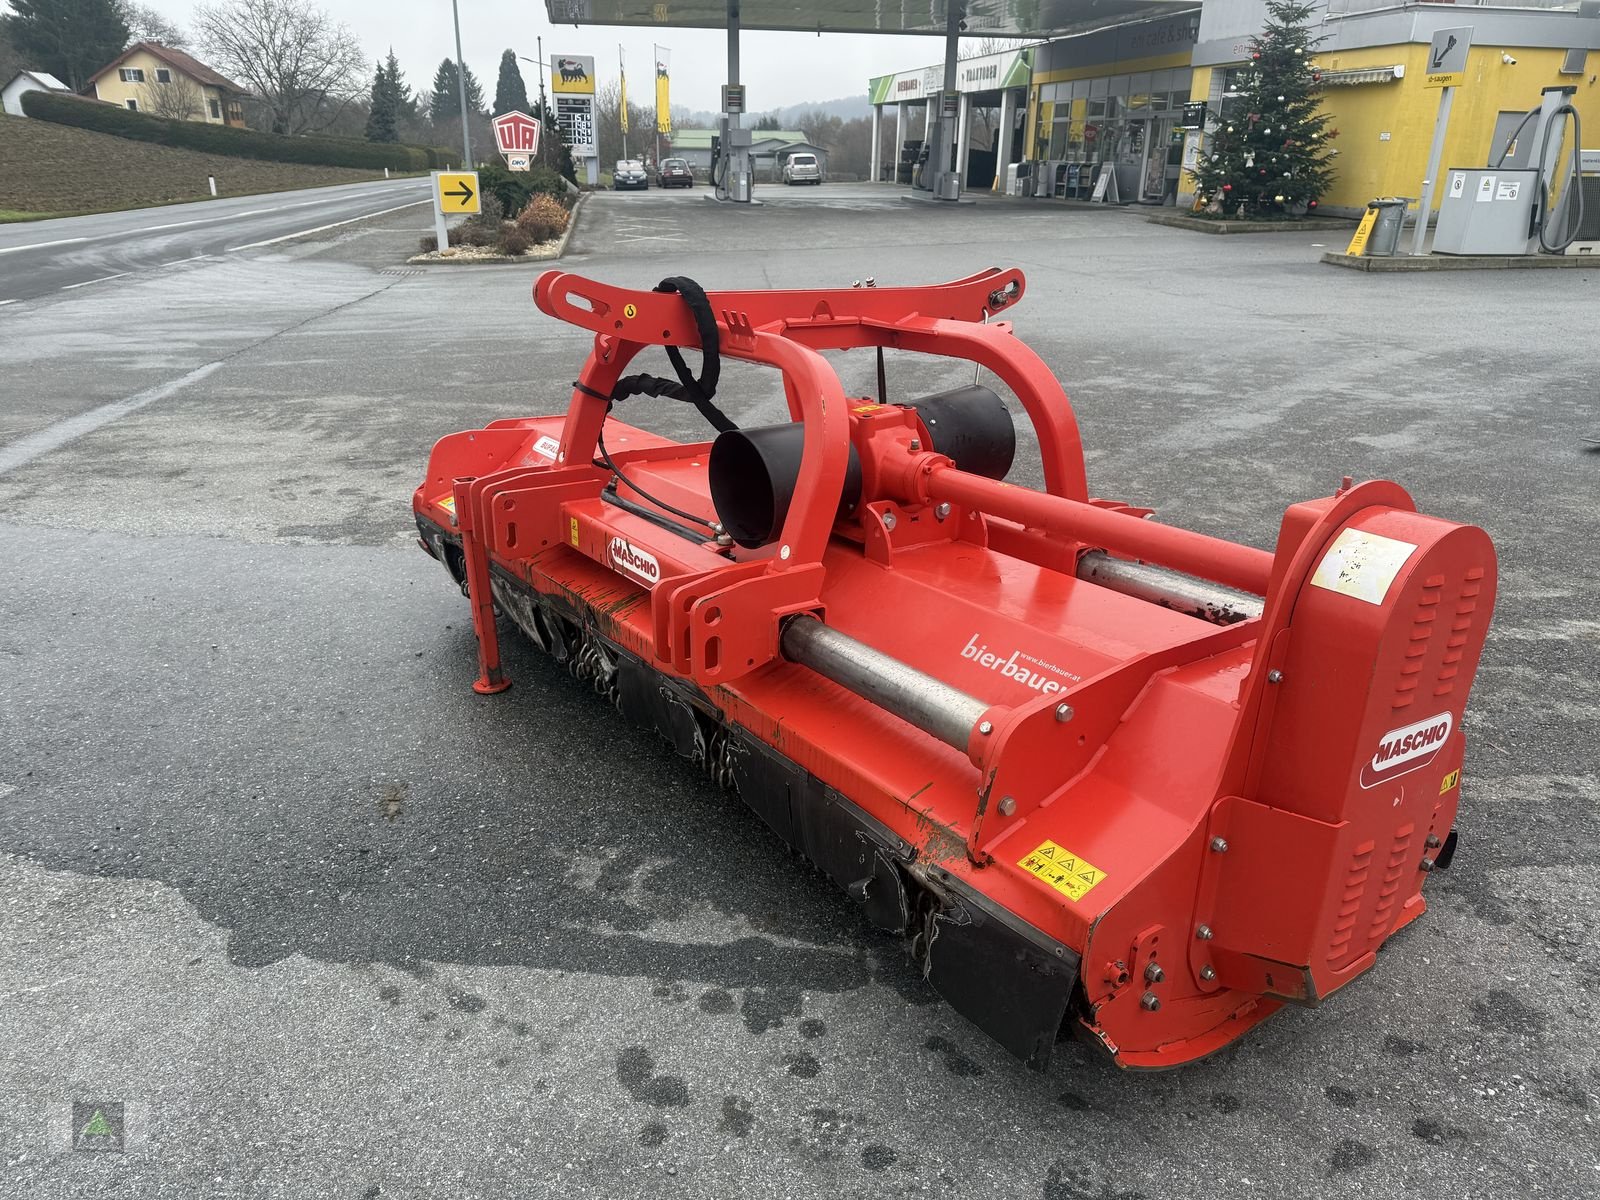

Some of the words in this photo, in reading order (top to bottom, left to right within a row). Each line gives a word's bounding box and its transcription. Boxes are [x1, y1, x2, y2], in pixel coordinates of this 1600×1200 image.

[497, 115, 536, 150] UTA
[613, 542, 657, 578] MASCHIO
[1020, 652, 1081, 682] www.bierbauer.at
[1375, 721, 1448, 765] MASCHIO
